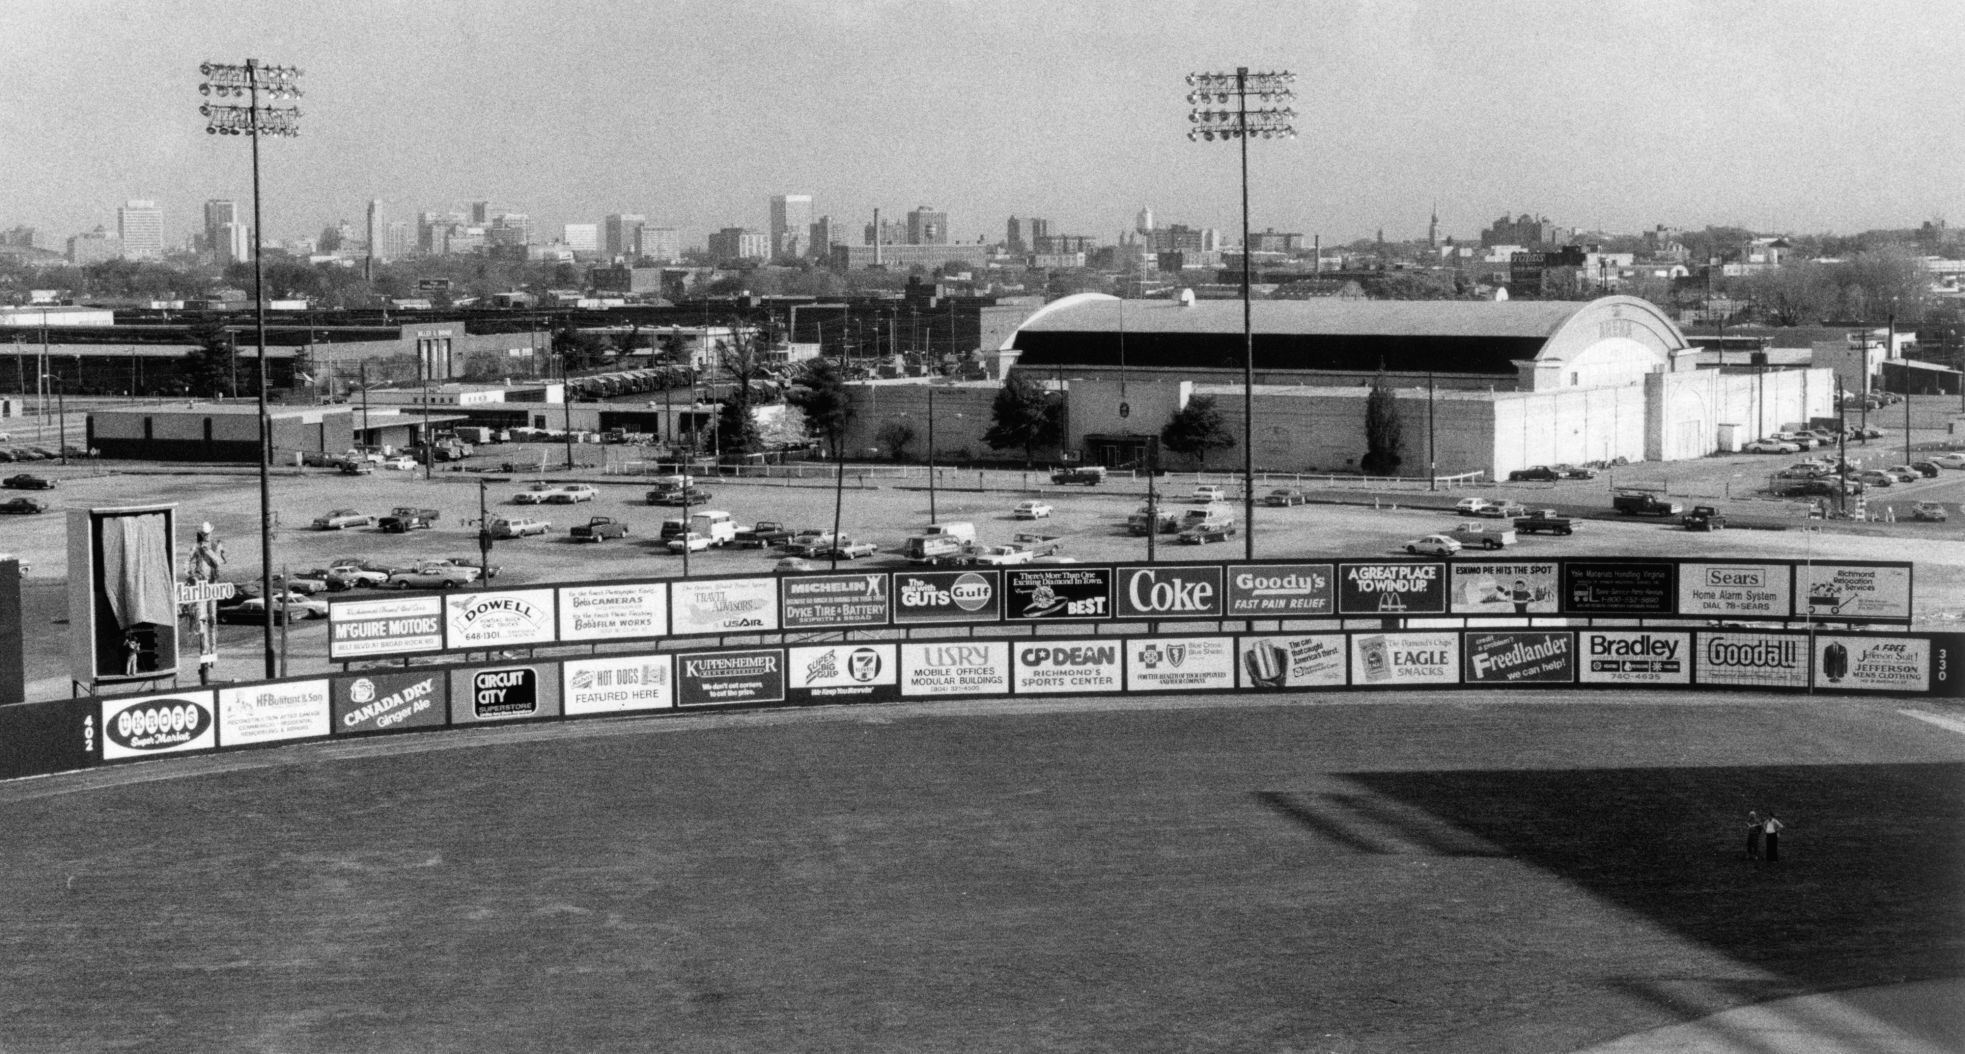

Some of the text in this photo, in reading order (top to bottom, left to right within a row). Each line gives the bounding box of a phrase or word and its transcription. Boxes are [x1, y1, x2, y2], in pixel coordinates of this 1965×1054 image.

[1045, 572, 1062, 580] More
[1062, 571, 1080, 579] Than
[1080, 571, 1096, 579] One
[1348, 566, 1436, 580] A GREAT PLACE
[1455, 565, 1553, 574] ESKIMO PIE HITS THE SPOT
[1837, 570, 1875, 578] Richmond
[907, 578, 925, 587] The
[1013, 578, 1042, 587] Exciting
[1042, 578, 1074, 586] Diamond
[1236, 573, 1325, 595] Goody's
[1710, 570, 1759, 585] Sears
[1833, 577, 1873, 585] Relocation
[791, 582, 866, 593] MICHELIN
[901, 583, 936, 593] gas with
[953, 586, 990, 598] Gulf
[1129, 569, 1213, 612] Coke
[1356, 580, 1374, 592] TO
[1374, 580, 1409, 592] WIND
[592, 596, 643, 605] CAMERAS
[695, 591, 728, 603] TRAVEL
[901, 590, 951, 607] GUTS
[1693, 589, 1777, 602] Home Alarm System
[711, 600, 753, 613] ADVISORS
[1067, 596, 1107, 615] BEST
[1234, 598, 1326, 609] FAST PAIN RELIEF
[465, 599, 533, 622] DOWELL
[787, 606, 813, 619] DYKE
[814, 604, 837, 617] TIRE
[842, 604, 886, 616] BATTERY
[335, 618, 437, 639] McGUIRE MOTORS
[575, 618, 596, 631] Bob's
[596, 619, 616, 628] FILM
[620, 618, 652, 627] WORKS
[1289, 638, 1312, 649] The can
[1291, 642, 1324, 657] that caught
[1483, 636, 1514, 651] problem?
[1590, 635, 1679, 660] Bradley
[1882, 644, 1907, 652] FREE
[924, 645, 989, 667] USRY
[1021, 646, 1115, 667] CP DEAN
[1293, 652, 1321, 665] America's
[1393, 650, 1449, 666] EAGLE
[1472, 635, 1567, 679] Freedlander
[1708, 636, 1796, 669] Goodall
[685, 656, 777, 678] KUPPENHEIMER
[856, 656, 873, 667] 7
[1938, 648, 1947, 681] 330
[817, 670, 839, 678] GULP
[914, 667, 995, 677] MOBILE OFFICES
[1033, 669, 1102, 678] RICHMOND'S
[1397, 667, 1444, 676] SNACKS
[1507, 657, 1566, 680] we can help!
[1855, 664, 1918, 673] JEFFERSON
[476, 671, 524, 689] CIRCUIT
[597, 669, 612, 686] HOT
[616, 668, 639, 685] DOGS
[911, 676, 1003, 686] MODULAR BUILDINGS
[1021, 677, 1114, 687] SPORTS CENTER
[1878, 672, 1921, 681] CLOTHING
[308, 693, 323, 703] Son
[478, 689, 507, 704] CITY
[575, 689, 660, 703] FEATURED HERE
[811, 688, 821, 696] We
[343, 678, 433, 726] CANADA DRY
[479, 703, 533, 713] SUPERSTORE
[376, 700, 431, 727] Ginger Ale
[119, 708, 197, 733] UKROPS
[130, 731, 191, 748] Super Market
